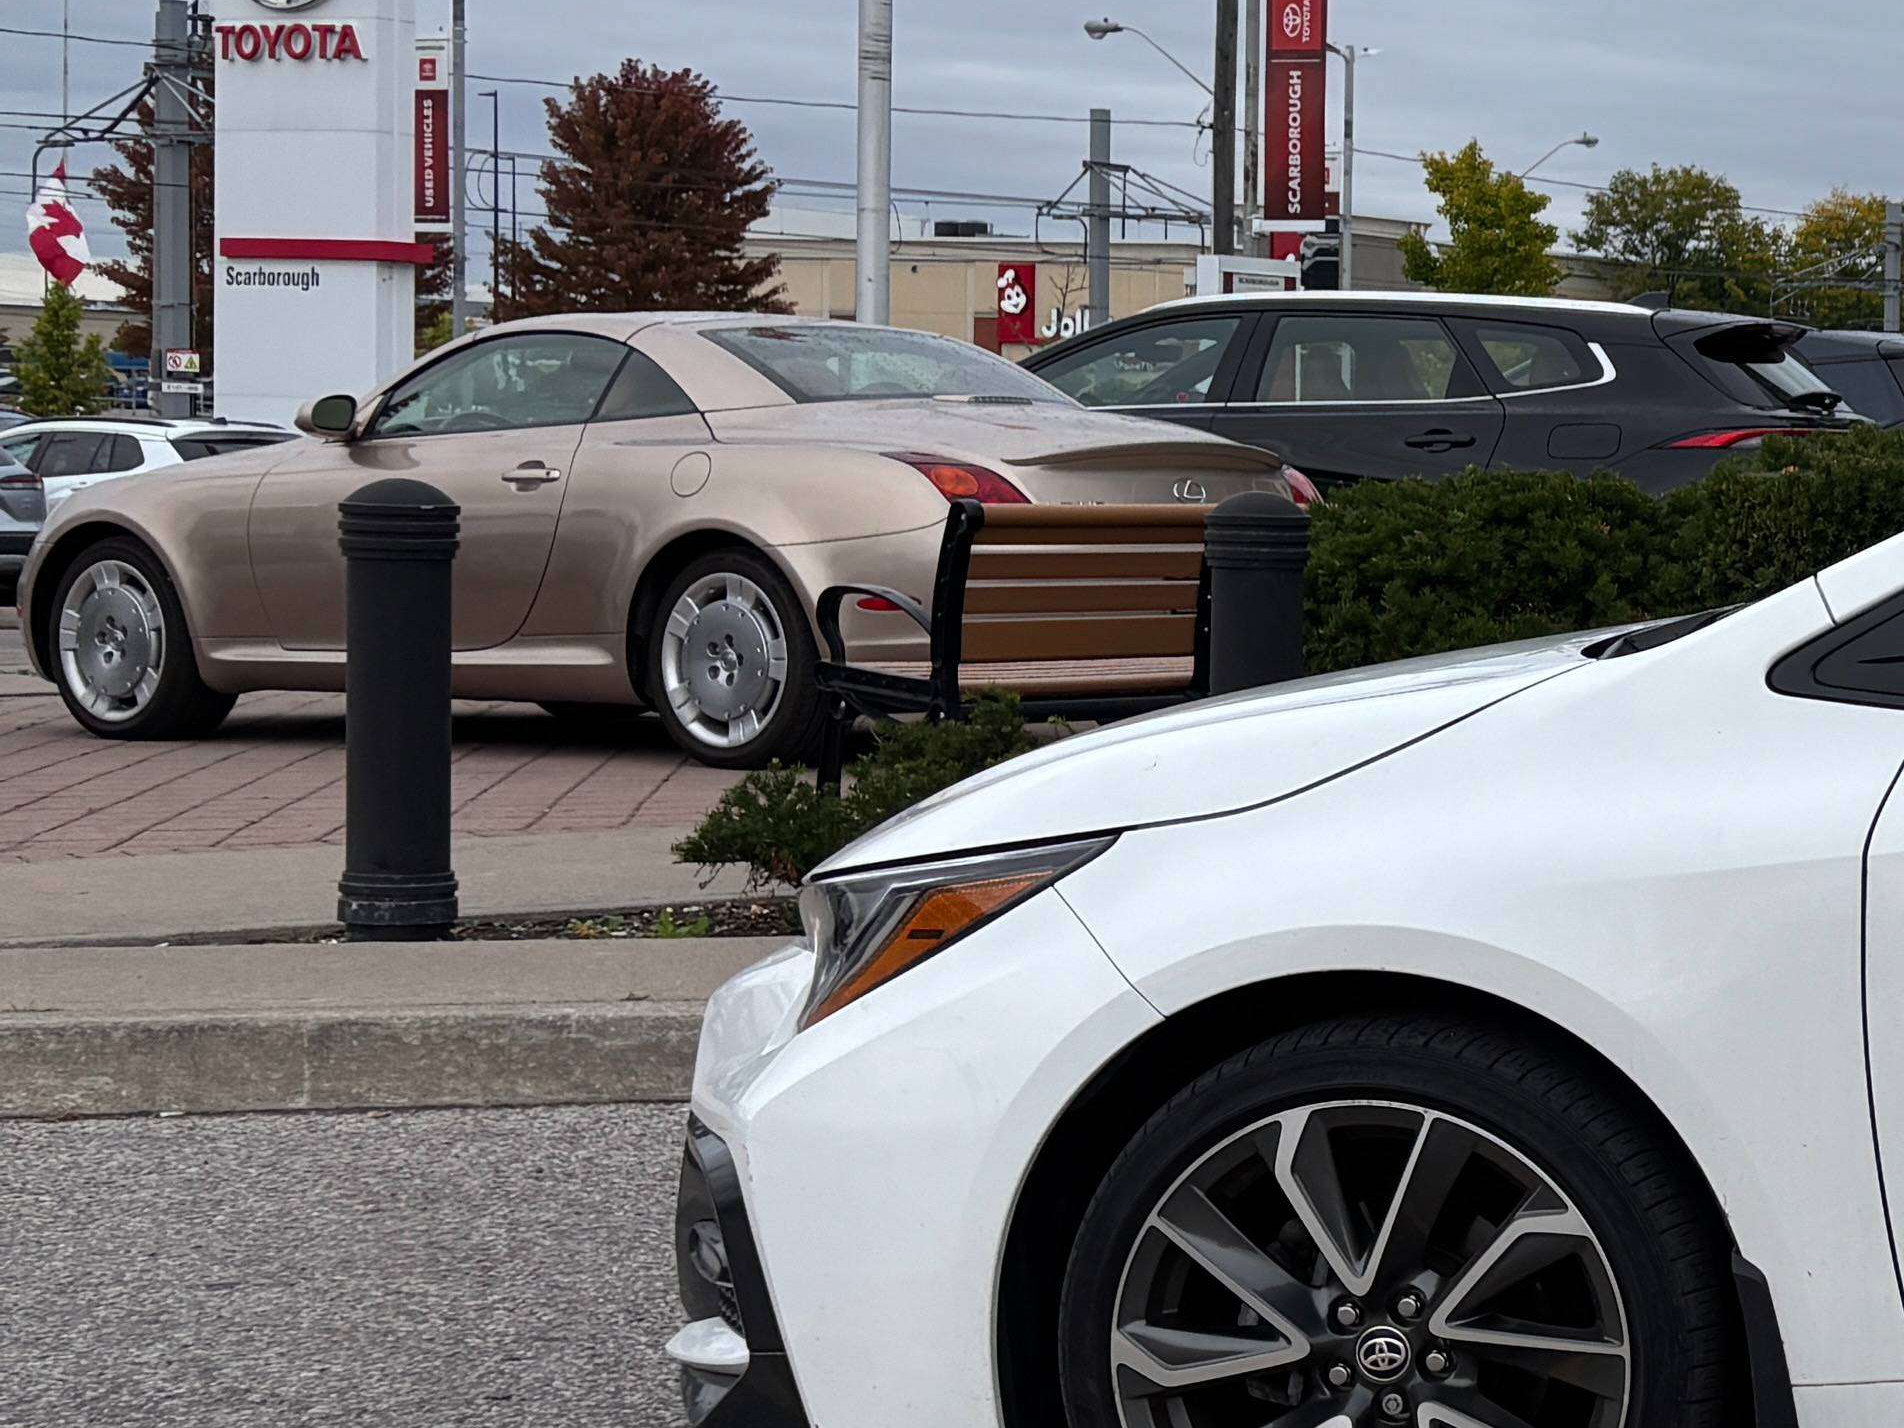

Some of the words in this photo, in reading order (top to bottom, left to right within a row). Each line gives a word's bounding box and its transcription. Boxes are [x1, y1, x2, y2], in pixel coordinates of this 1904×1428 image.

[215, 24, 366, 61] TOYOTA
[423, 98, 434, 167] VEHICLES
[1288, 70, 1302, 214] SCARBOROUGH
[424, 168, 434, 208] USED
[225, 265, 320, 291] Scarborough
[1041, 307, 1092, 339] Joll
